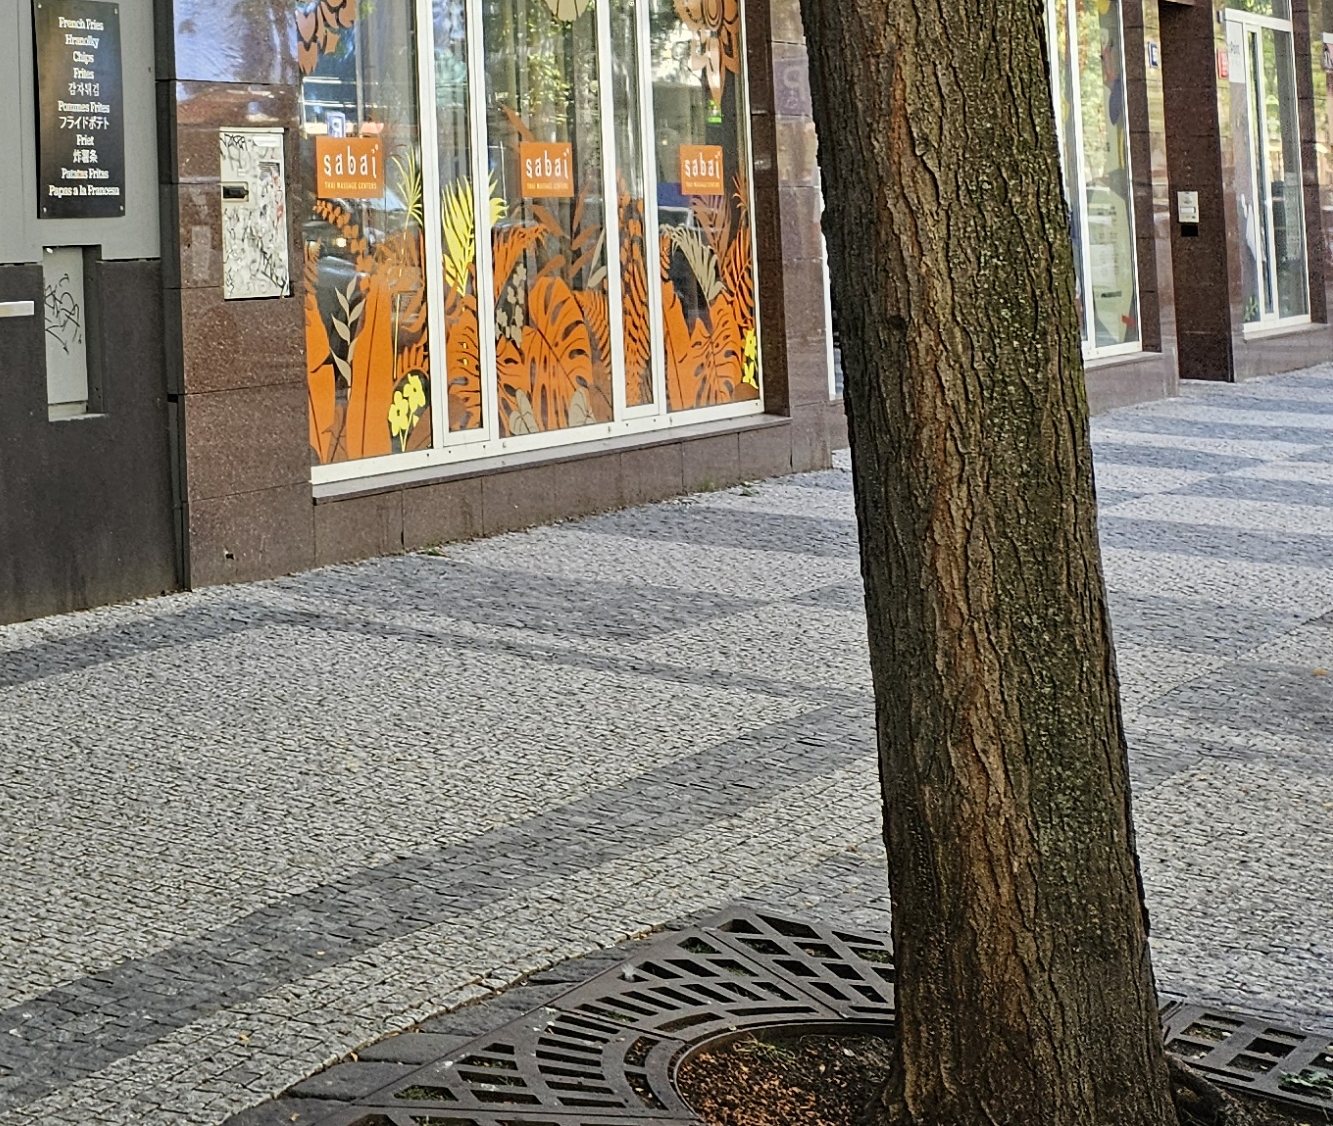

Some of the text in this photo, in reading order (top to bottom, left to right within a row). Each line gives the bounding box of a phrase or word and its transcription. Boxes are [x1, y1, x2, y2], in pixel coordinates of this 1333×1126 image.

[58, 16, 104, 31] French Fries
[73, 50, 95, 65] Chips
[73, 67, 95, 80] Frites
[90, 101, 110, 113] Frites
[58, 115, 110, 130] フライドポテト
[48, 184, 73, 198] Papas
[79, 184, 87, 196] la
